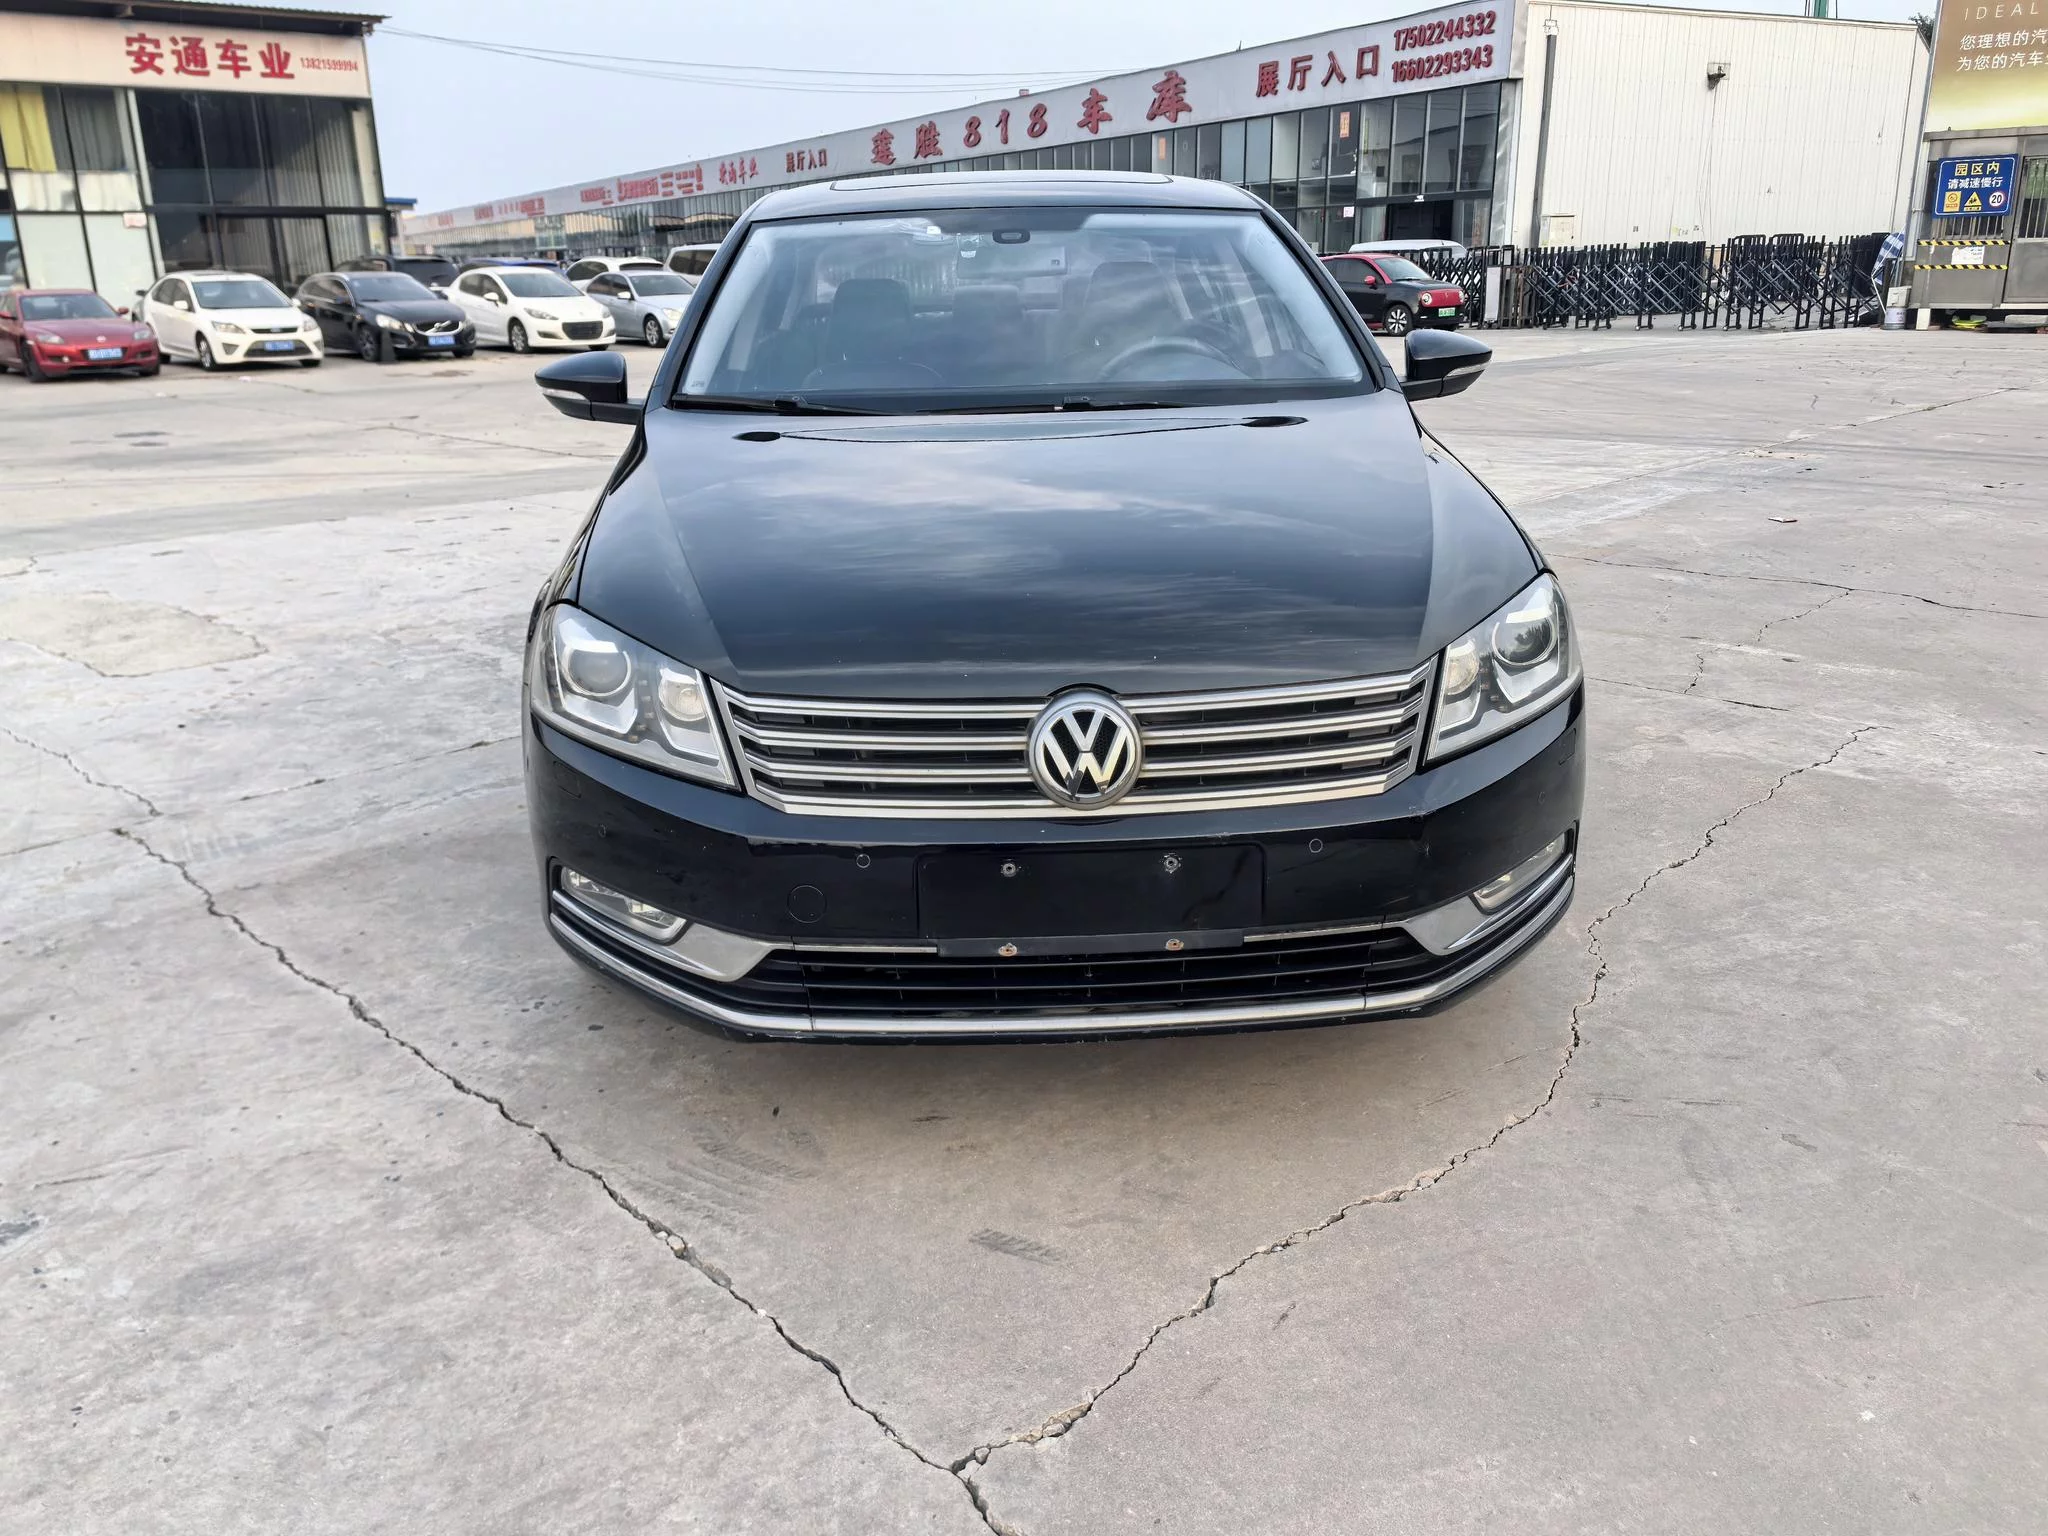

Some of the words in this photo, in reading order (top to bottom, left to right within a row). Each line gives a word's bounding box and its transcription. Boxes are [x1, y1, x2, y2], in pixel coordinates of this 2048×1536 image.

[1964, 2, 2039, 21] IDEAL
[1393, 10, 1497, 51] 17502244332
[1959, 28, 2048, 51] 您理想的汽
[124, 33, 295, 79] 安通车业
[1391, 44, 1494, 82] 16602293343
[1956, 50, 2048, 73] 为您的汽车
[1256, 44, 1381, 97] 展厅入口
[785, 148, 828, 173] 展厅入口
[1954, 161, 2000, 176] 园区内
[1947, 176, 2003, 190] 请减速慢行
[1991, 194, 2002, 204] 20
